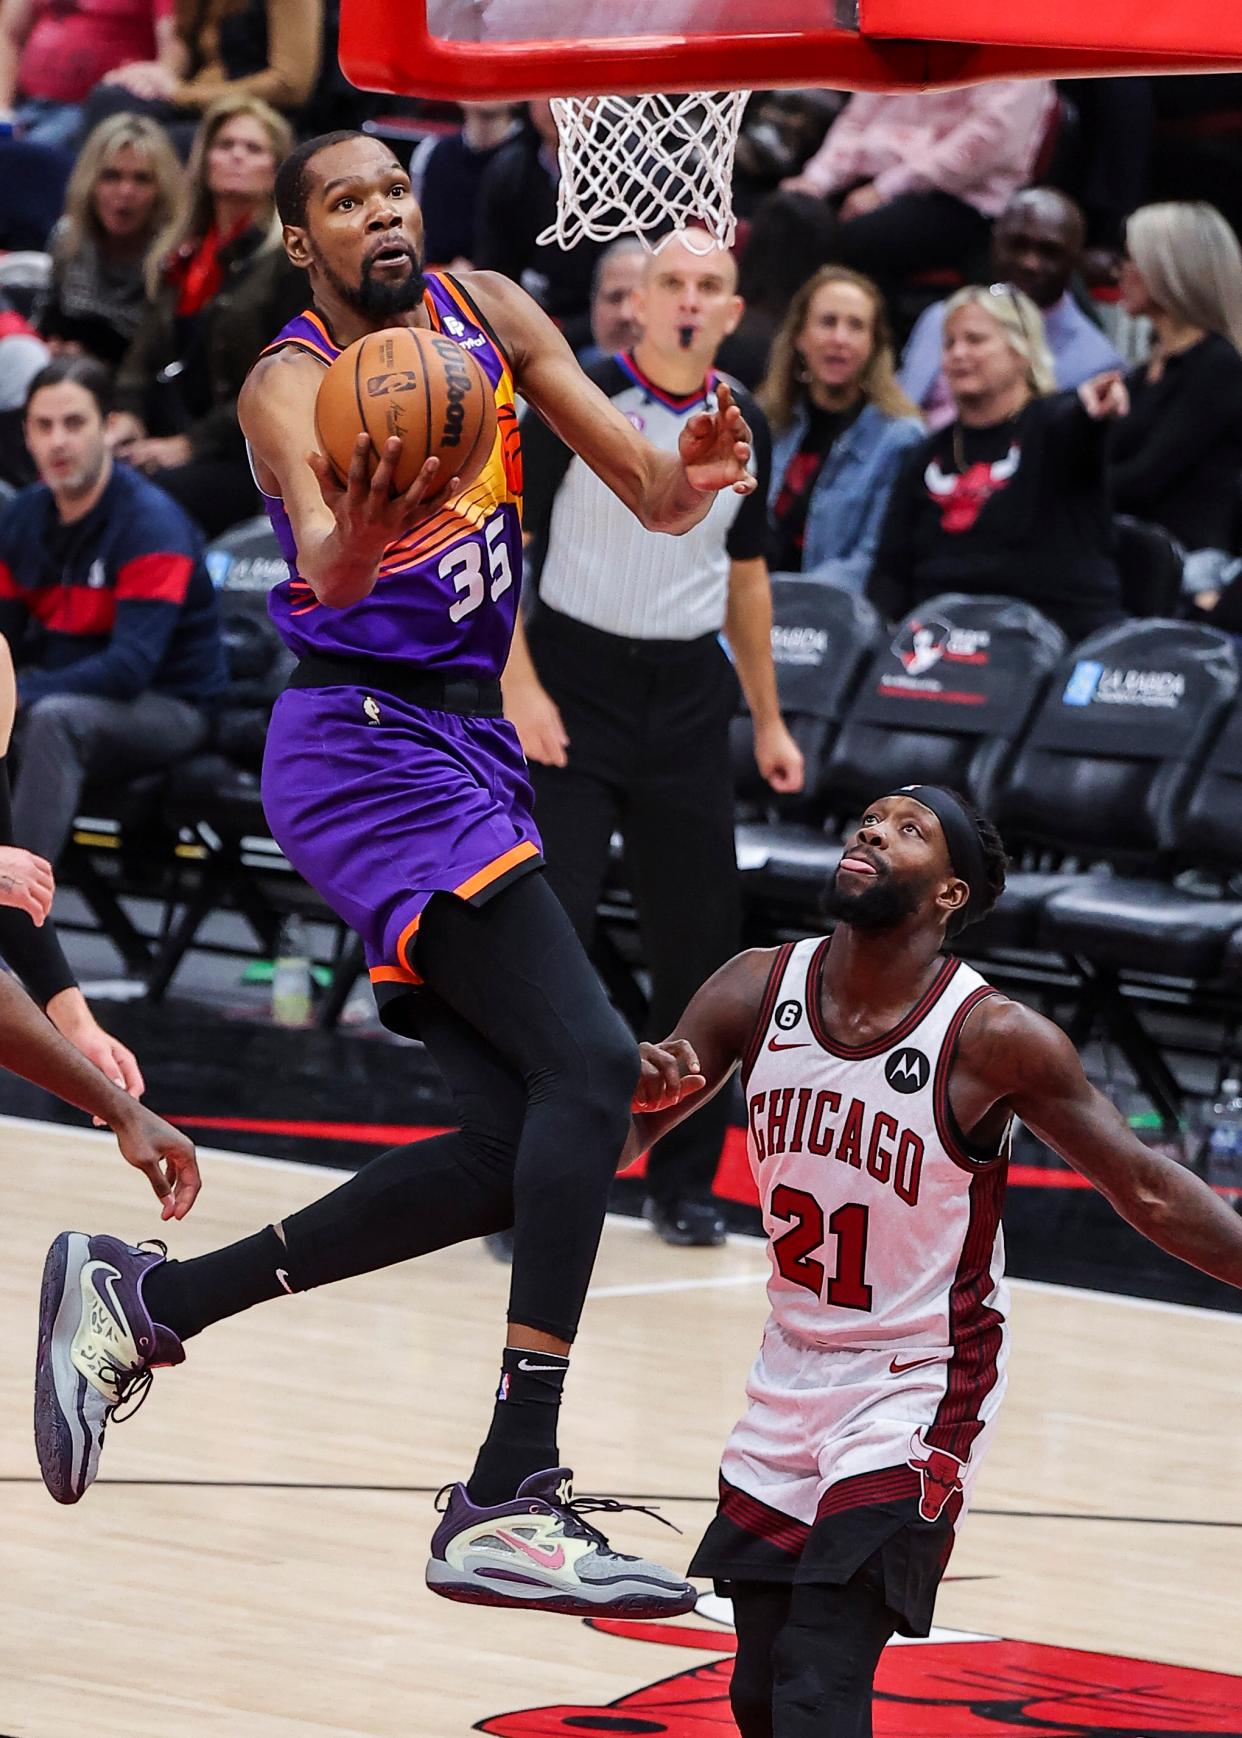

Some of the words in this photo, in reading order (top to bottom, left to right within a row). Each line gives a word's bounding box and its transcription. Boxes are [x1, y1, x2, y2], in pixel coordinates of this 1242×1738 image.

[431, 338, 472, 447] Wilson
[437, 513, 512, 623] 35
[780, 1003, 799, 1027] 6
[749, 1087, 925, 1207] CHICAGO
[769, 1182, 873, 1313] 21
